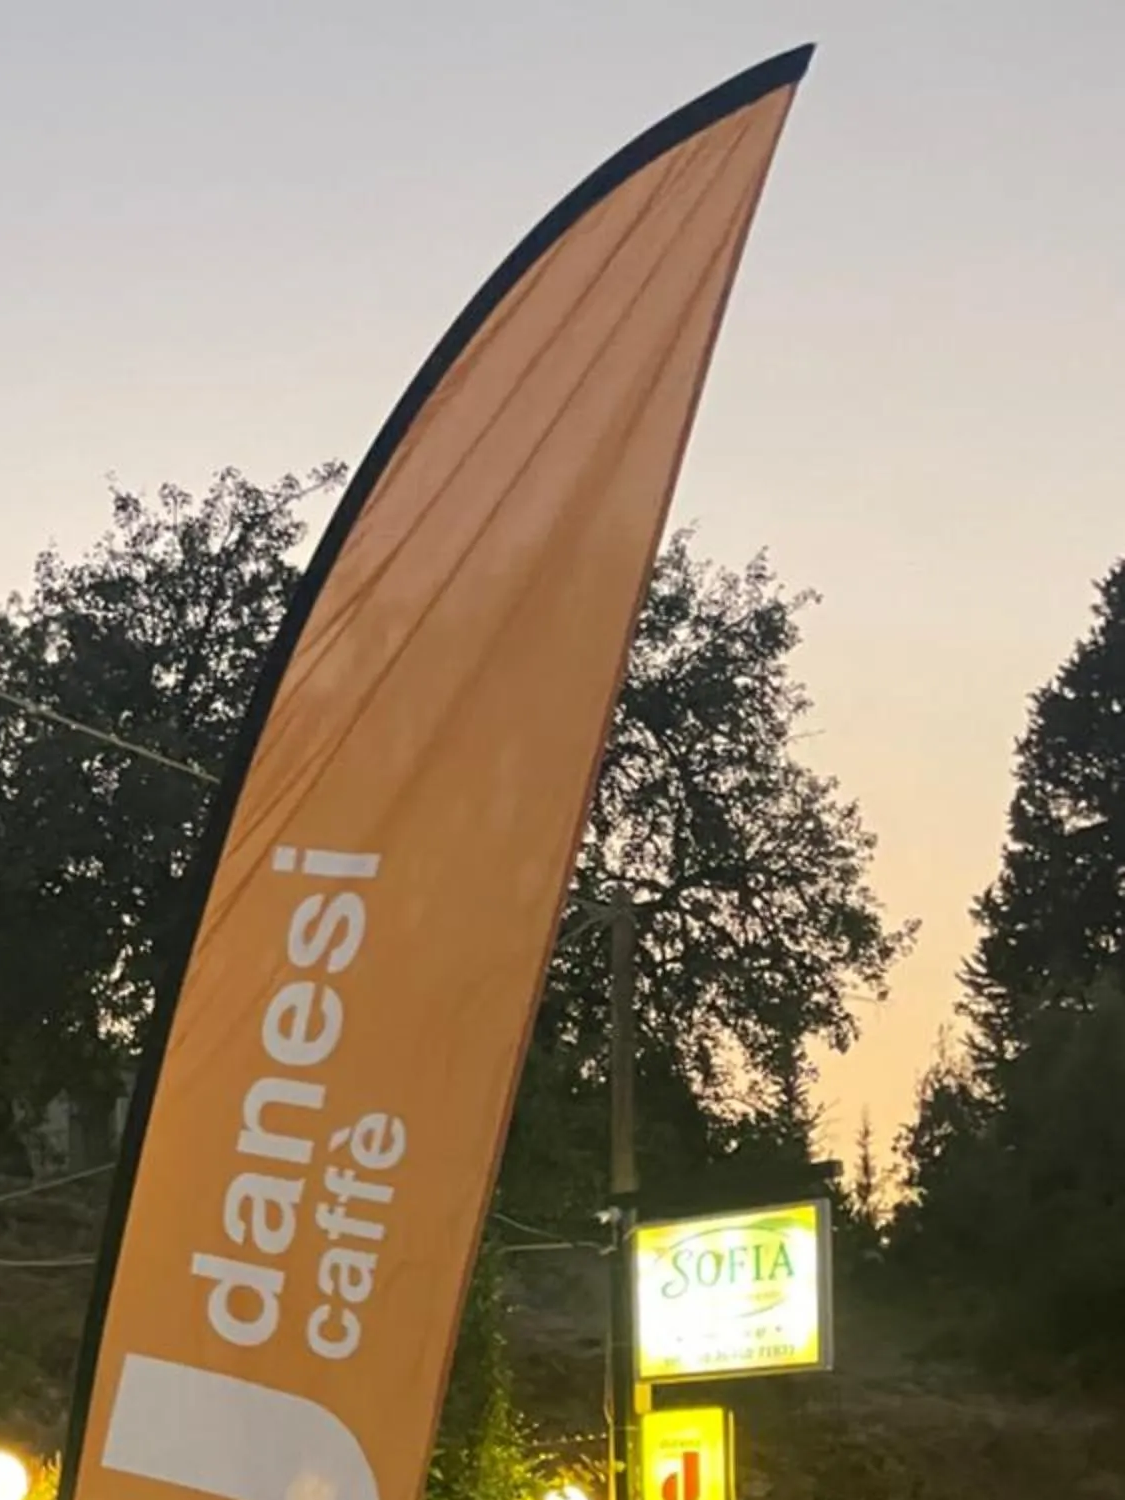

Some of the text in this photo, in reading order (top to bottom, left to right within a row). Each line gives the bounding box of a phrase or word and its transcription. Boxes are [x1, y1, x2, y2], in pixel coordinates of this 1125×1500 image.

[192, 846, 382, 1347] danesi
[306, 1111, 406, 1360] caffè
[661, 1240, 796, 1299] SOFIA
